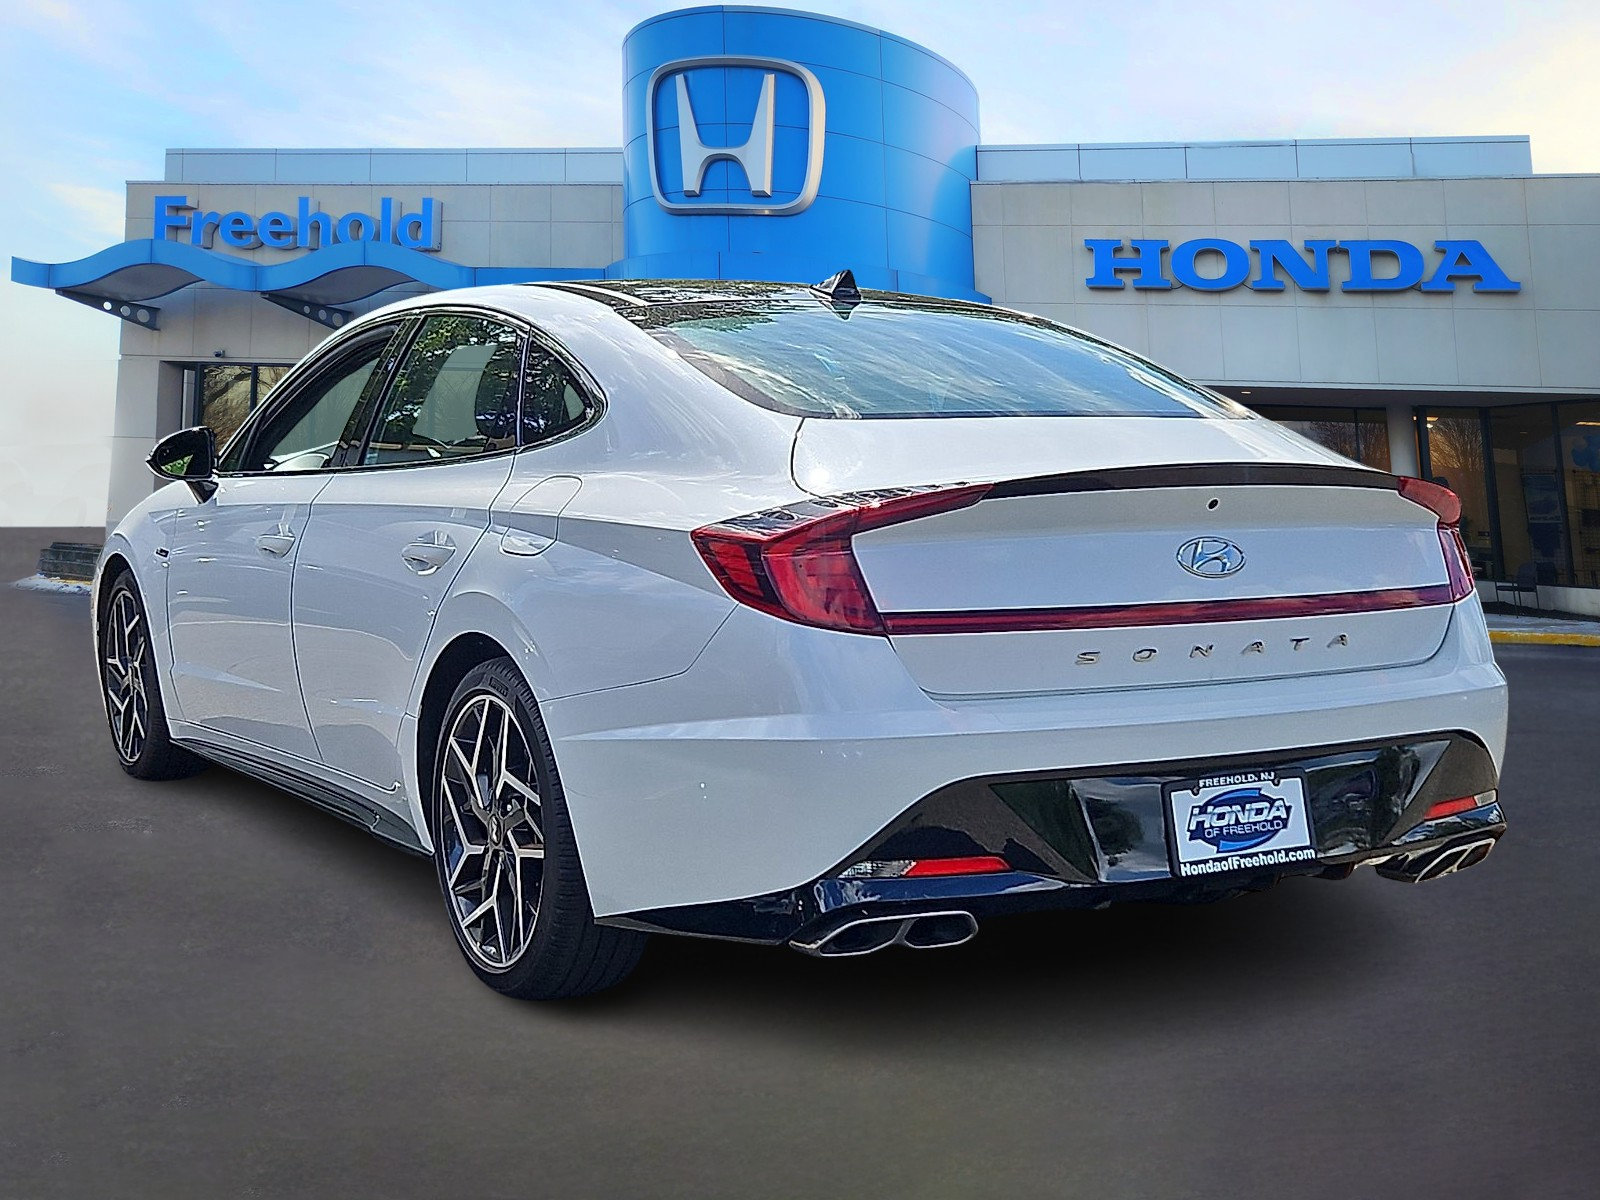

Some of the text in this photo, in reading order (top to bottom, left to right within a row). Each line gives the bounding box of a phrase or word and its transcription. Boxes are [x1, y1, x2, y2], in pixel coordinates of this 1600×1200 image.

[153, 195, 434, 249] Freehold
[1084, 238, 1522, 293] HONDA
[1074, 633, 1349, 665] SONATA
[1260, 771, 1275, 780] NJ
[1189, 799, 1287, 831] HONDA
[1204, 820, 1283, 838] OF FREEHOLD
[1180, 848, 1316, 877] HondaofFreehold.com
